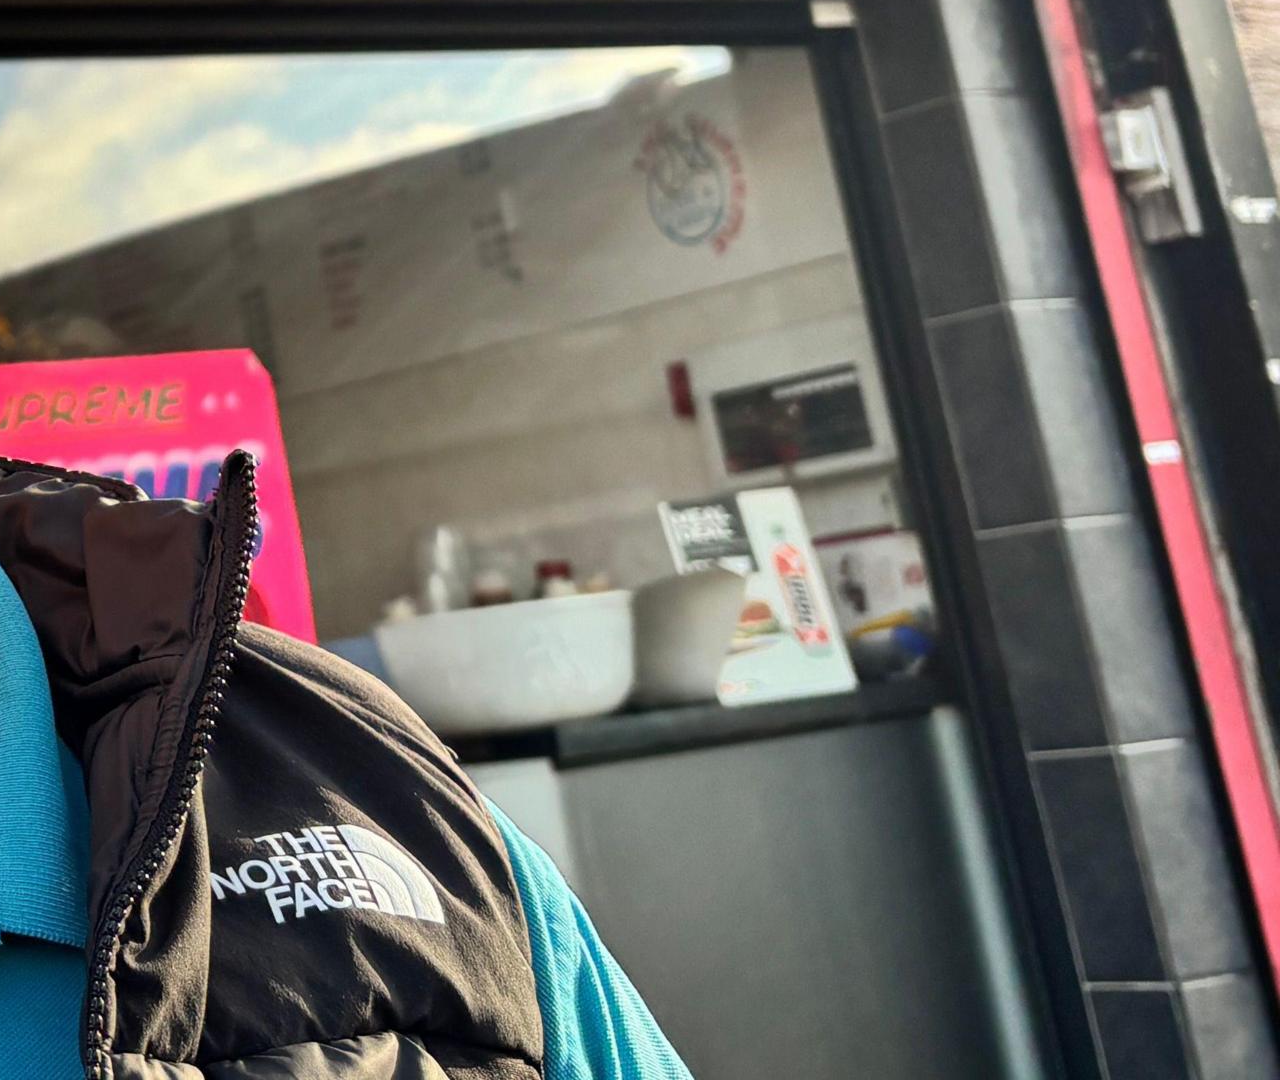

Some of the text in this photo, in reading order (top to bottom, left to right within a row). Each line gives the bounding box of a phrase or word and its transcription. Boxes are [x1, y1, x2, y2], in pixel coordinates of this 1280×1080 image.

[255, 825, 346, 857] THE
[210, 850, 362, 901] NORTH
[265, 878, 380, 925] FACE
